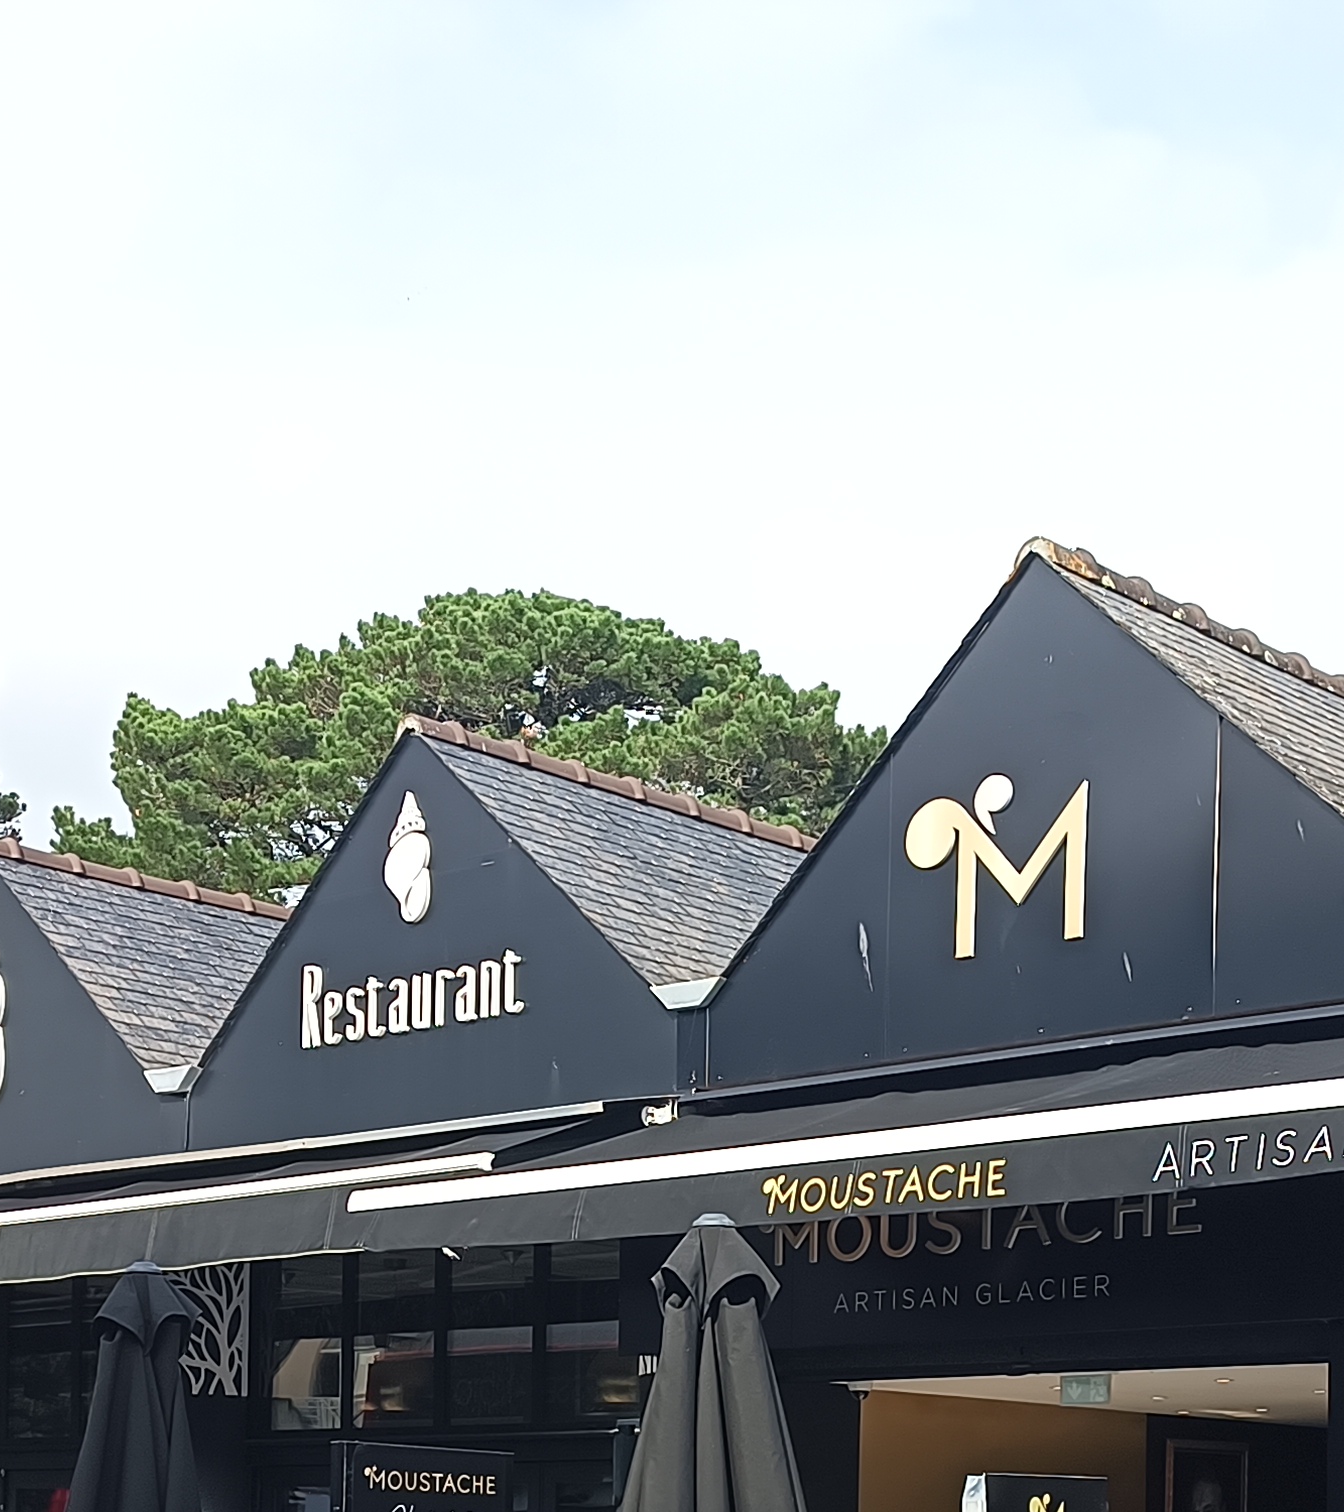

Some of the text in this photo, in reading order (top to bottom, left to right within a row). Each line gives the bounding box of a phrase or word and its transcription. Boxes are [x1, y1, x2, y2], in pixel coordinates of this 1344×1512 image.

[301, 948, 526, 1049] Restaurant
[762, 1158, 1007, 1216] MOUSTACHE
[833, 1274, 1111, 1314] ARTISAN GLACIER
[364, 1465, 497, 1495] MOUSTACHE
